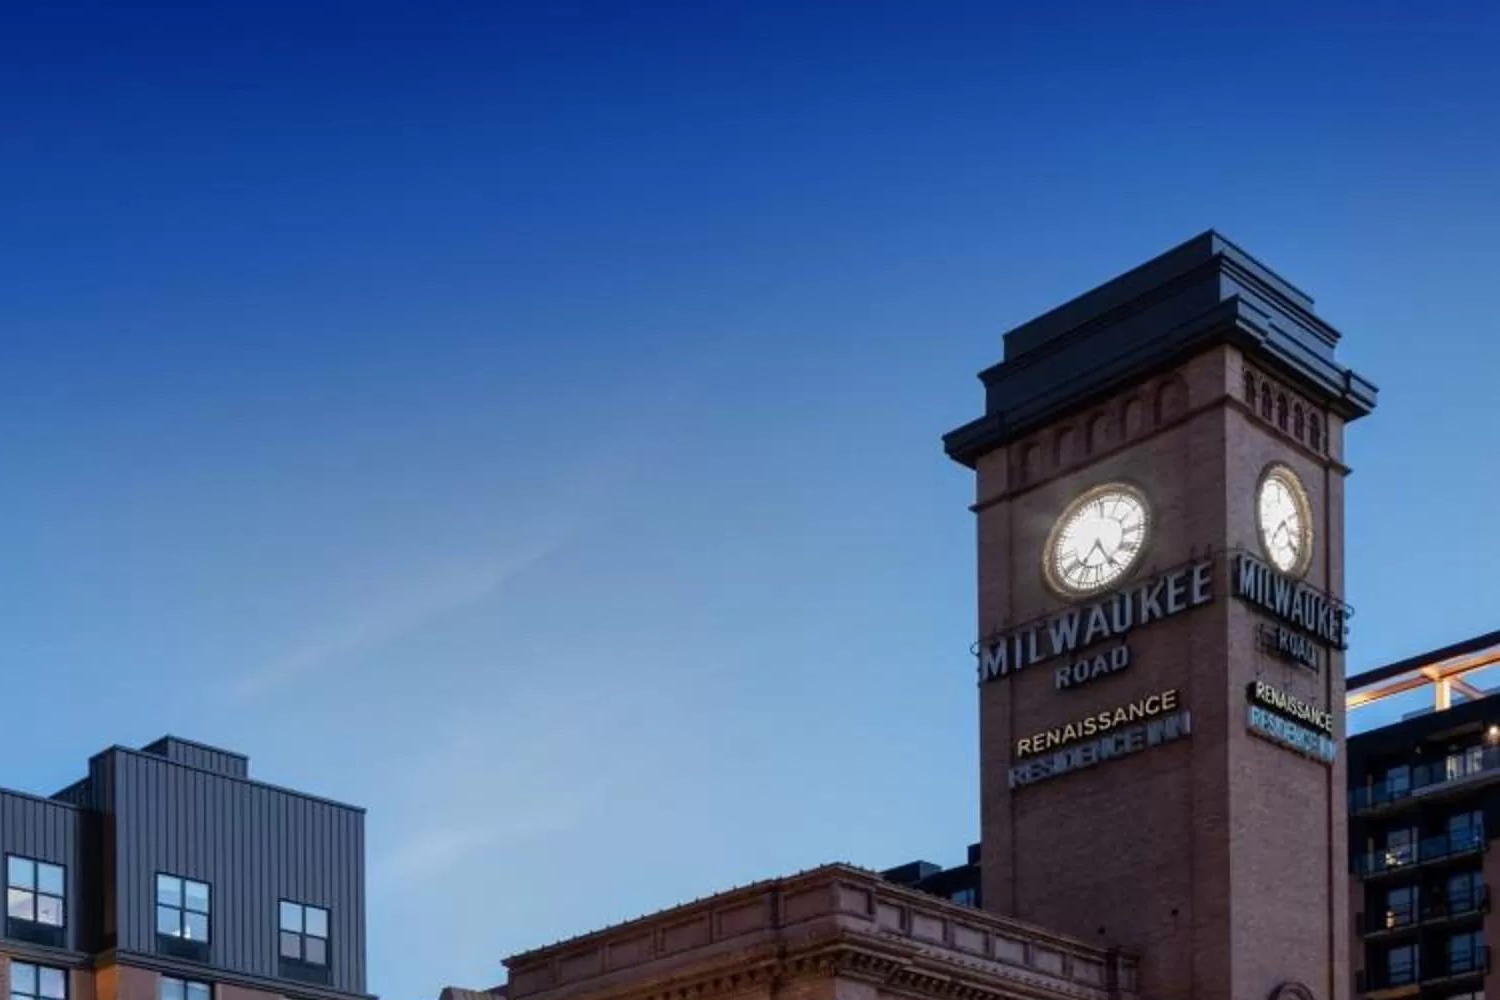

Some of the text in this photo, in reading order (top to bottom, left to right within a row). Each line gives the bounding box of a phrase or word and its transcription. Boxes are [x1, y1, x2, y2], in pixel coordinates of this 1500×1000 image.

[982, 562, 1213, 681] MILWAUKEE
[1240, 555, 1348, 650] MILWAUKEE
[1055, 645, 1129, 688] ROAD
[1279, 626, 1317, 668] ROAD
[1017, 689, 1177, 757] RENAISSANCE
[1256, 681, 1333, 732] RENAISSANCE
[1008, 726, 1145, 788] RESIDENCE
